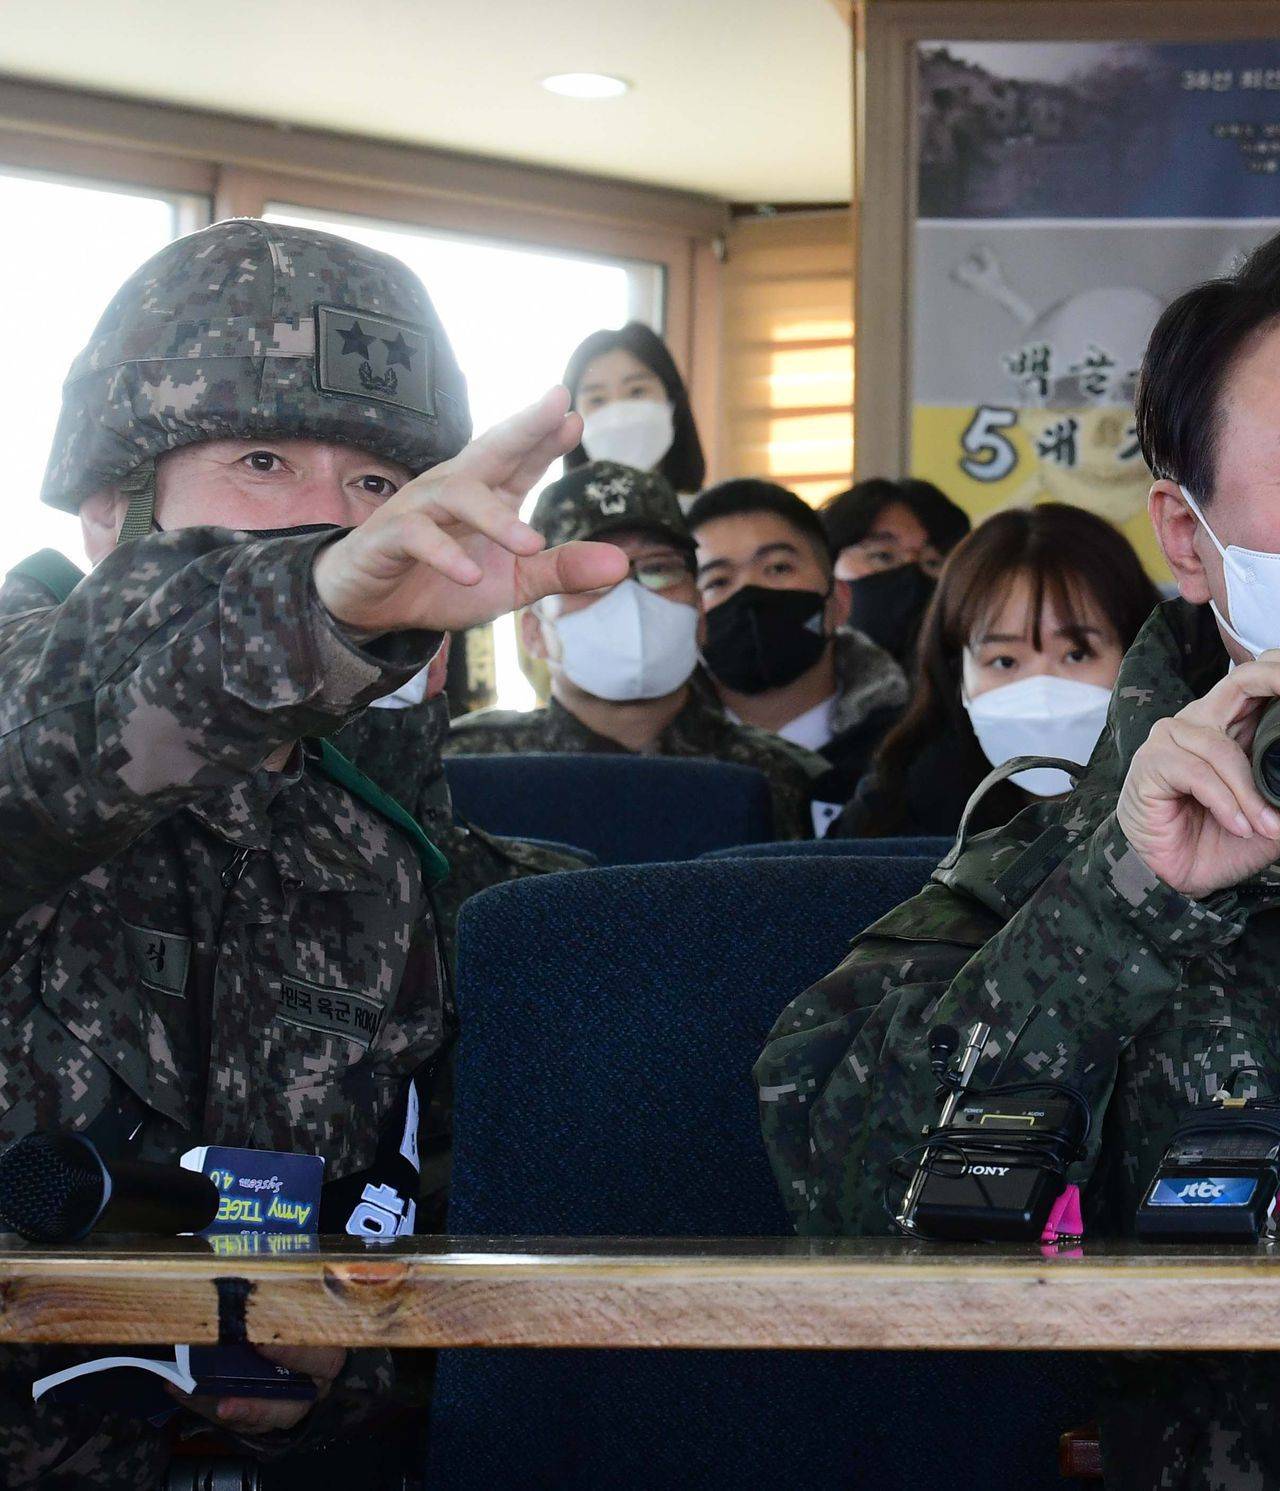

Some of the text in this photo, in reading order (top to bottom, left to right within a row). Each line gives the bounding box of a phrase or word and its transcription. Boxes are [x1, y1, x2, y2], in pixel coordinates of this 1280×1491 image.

[317, 997, 351, 1024] 육군
[239, 1176, 284, 1193] System
[216, 1196, 312, 1225] Army TIGE
